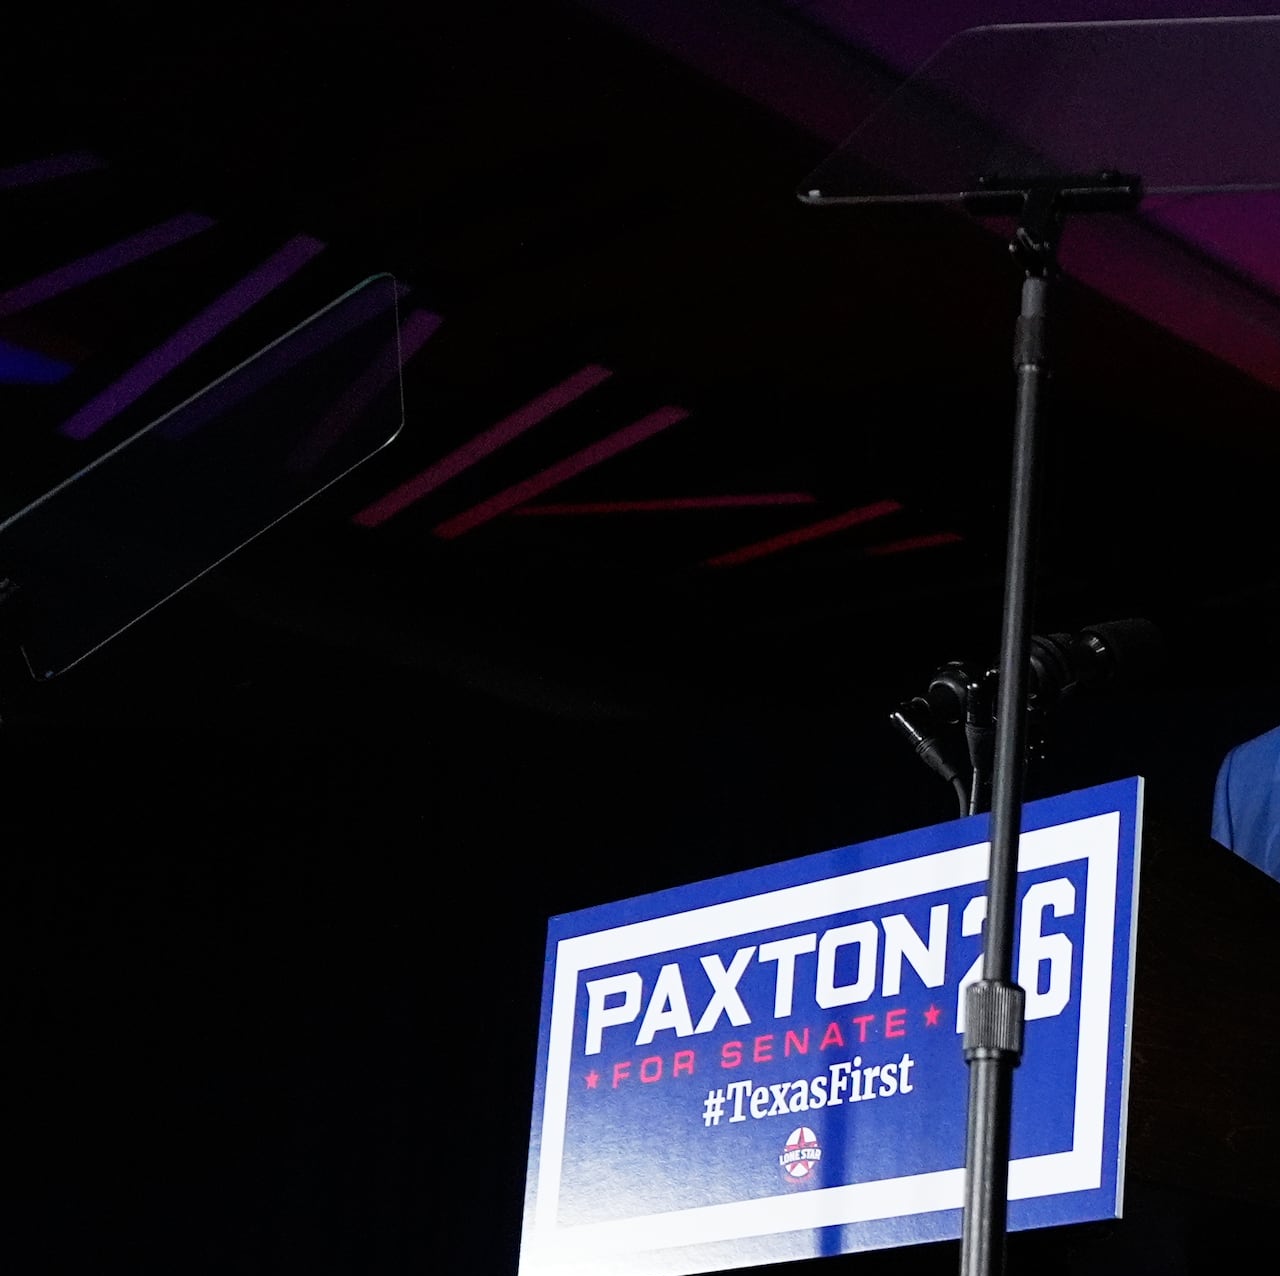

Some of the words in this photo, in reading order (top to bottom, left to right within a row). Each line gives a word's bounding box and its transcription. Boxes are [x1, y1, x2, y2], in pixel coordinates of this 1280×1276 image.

[585, 903, 949, 1056] PAXTON
[612, 1050, 696, 1089] FOR
[720, 1008, 908, 1069] SENATE
[702, 1053, 915, 1127] #TexasFirst
